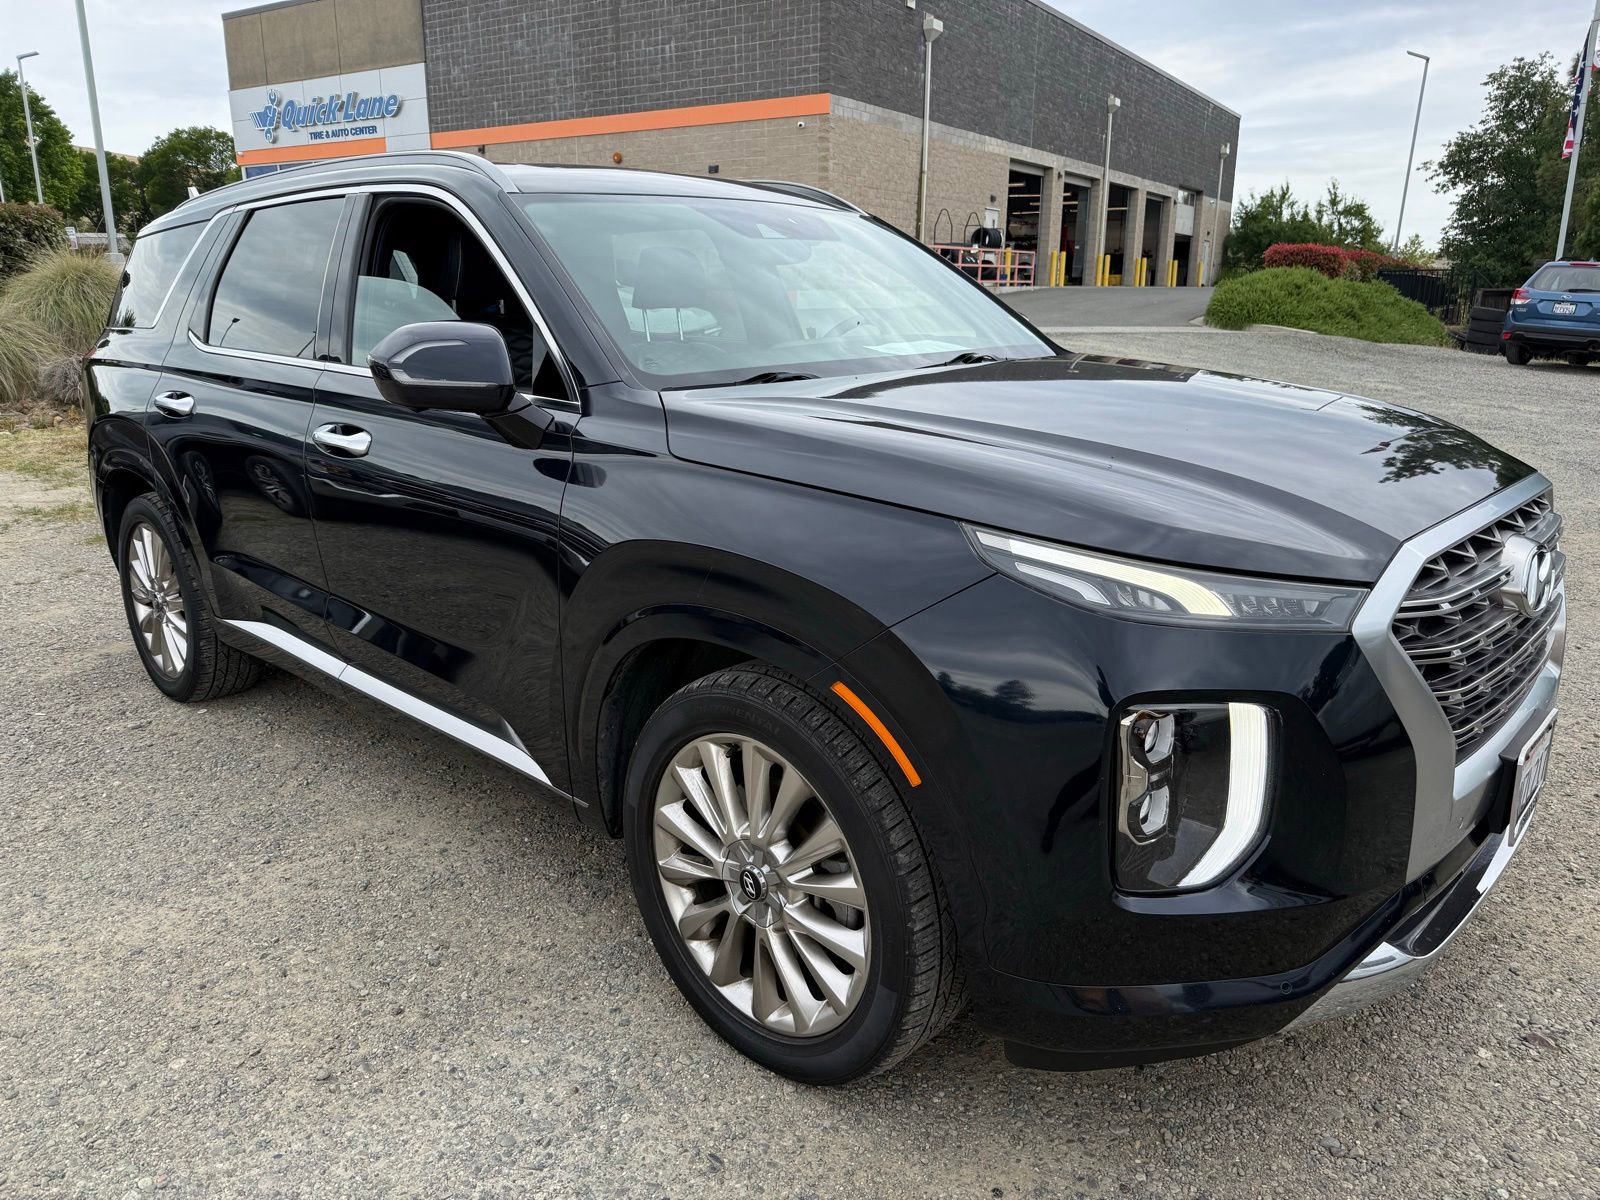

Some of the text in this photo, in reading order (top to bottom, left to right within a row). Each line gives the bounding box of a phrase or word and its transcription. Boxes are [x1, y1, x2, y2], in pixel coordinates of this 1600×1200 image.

[281, 91, 400, 130] Quick Lane
[309, 125, 378, 140] TIRE & AUTO CENTER
